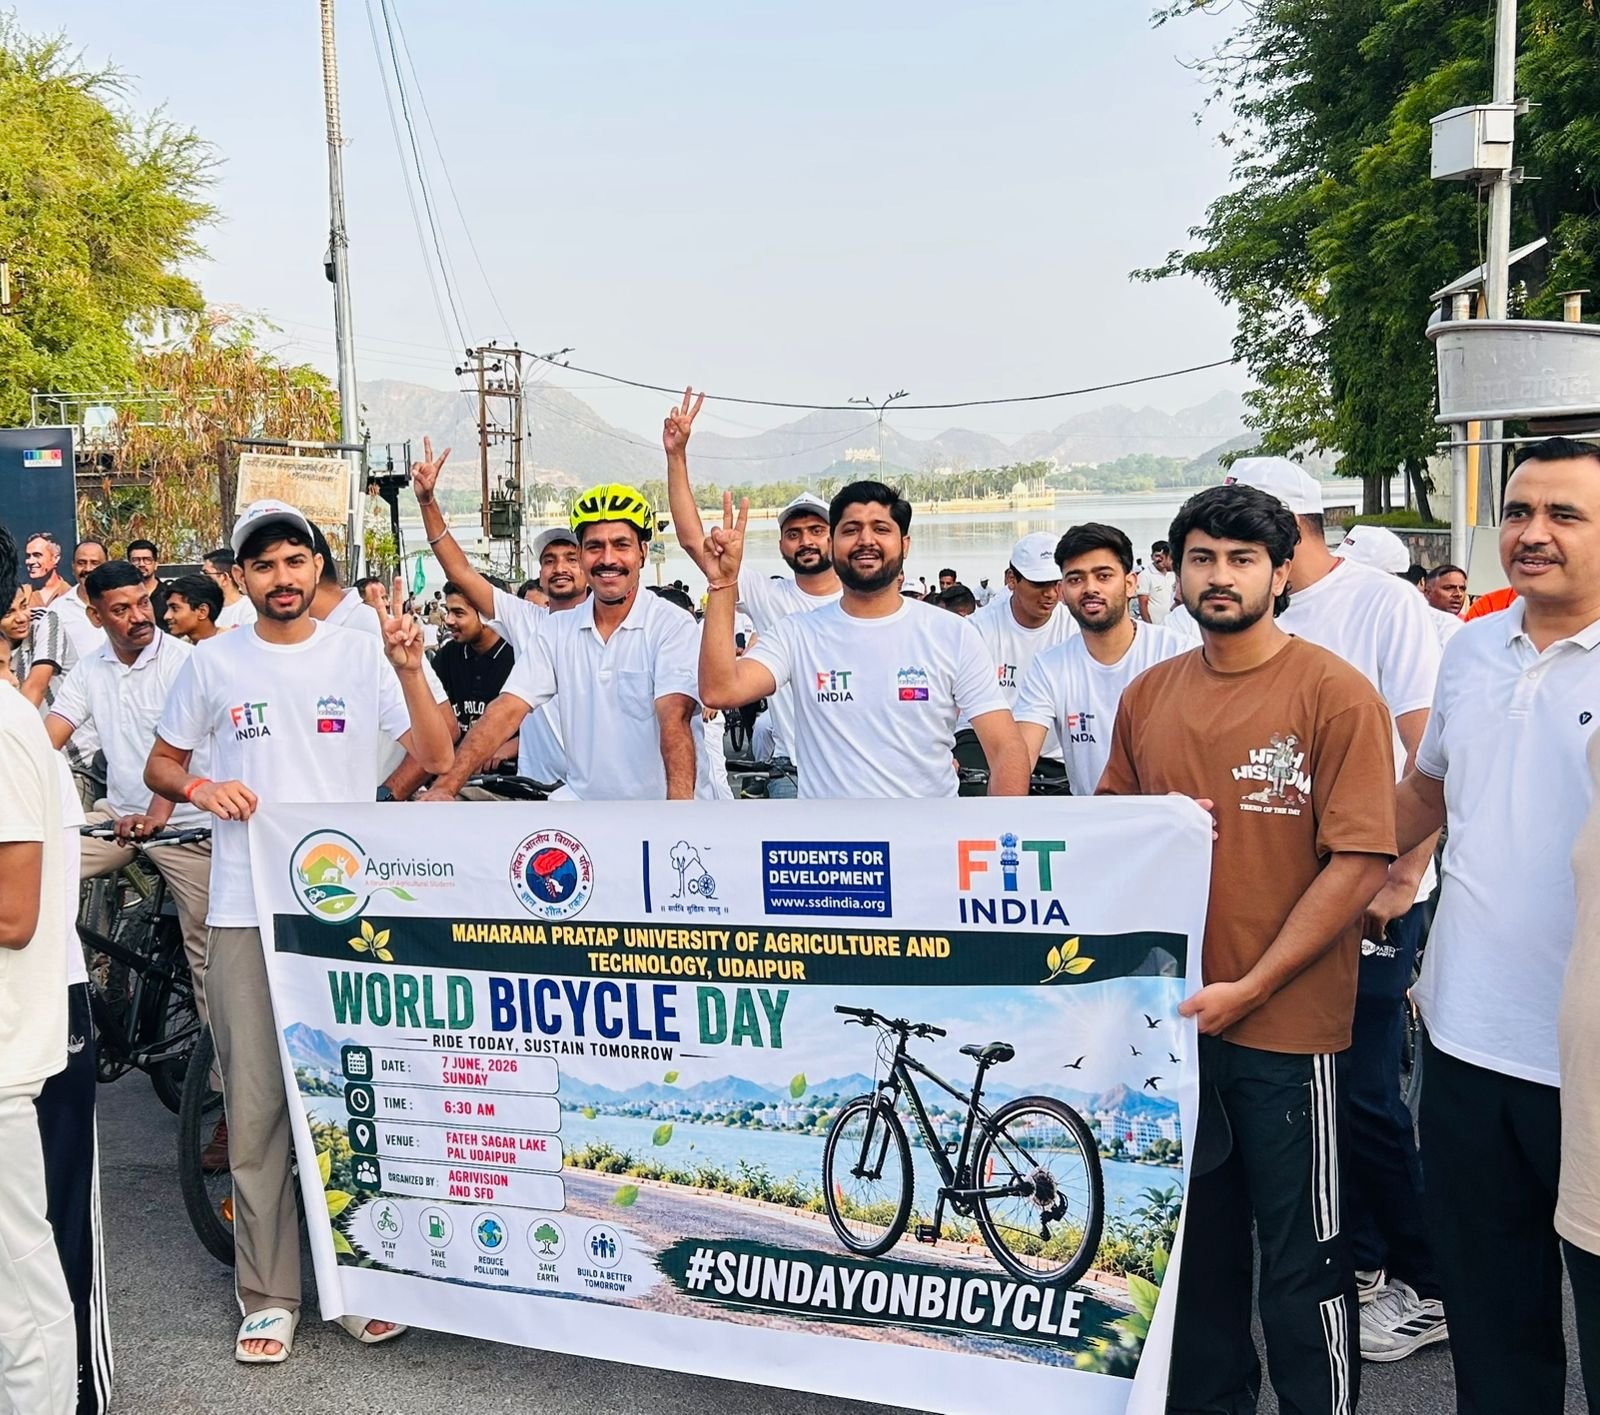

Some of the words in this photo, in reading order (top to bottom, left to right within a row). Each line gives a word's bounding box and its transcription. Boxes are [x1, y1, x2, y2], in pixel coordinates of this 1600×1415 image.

[817, 691, 854, 703] INDIA
[464, 700, 486, 715] POLO
[235, 725, 271, 741] INDIA
[769, 850, 849, 865] STUDENTS
[853, 851, 885, 866] FOR
[365, 857, 455, 881] Agrivision
[769, 870, 885, 886] DEVELOPMENT
[771, 896, 886, 912] www.ssdindia.org
[959, 898, 1071, 926] INDIA
[452, 924, 547, 945] MAHARANA
[551, 926, 619, 947] PRATAP
[622, 928, 730, 951] UNIVERSITY
[735, 931, 759, 953] OF
[763, 933, 902, 957] AGRICULTURE
[906, 937, 952, 959] AND
[587, 952, 712, 980] TECHNOLOGY,
[717, 957, 807, 981] UDAIPUR
[327, 970, 475, 1031] WORLD
[488, 976, 681, 1043] BICYCLE
[696, 985, 791, 1050] DAY
[432, 1034, 463, 1049] RIDE
[470, 1036, 519, 1053] TODAY,
[524, 1038, 585, 1057] SUSTAIN
[590, 1042, 674, 1061] TOMORROW
[442, 1056, 449, 1069] 7
[452, 1058, 484, 1073] JUNE,
[488, 1059, 518, 1073] 2026
[442, 1072, 489, 1087] SUNDAY
[444, 1100, 472, 1115] 6:30
[477, 1103, 496, 1117] AM
[446, 1131, 478, 1147] FATEH
[481, 1135, 516, 1150] SAGAR
[519, 1139, 547, 1153] LAKE
[447, 1146, 467, 1160] PAL
[470, 1148, 517, 1165] UDAIPUR
[388, 1171, 424, 1185] ORGANIZED
[448, 1169, 509, 1187] AGRIVISION
[449, 1184, 471, 1198] AND
[474, 1186, 494, 1200] SFD
[381, 1241, 396, 1251] STAY
[430, 1249, 446, 1259] SAVE
[384, 1250, 394, 1260] FIT
[478, 1256, 504, 1267] REDUCE
[431, 1259, 447, 1269] FUEL
[474, 1266, 510, 1278] POLLUTION
[538, 1263, 557, 1274] SAVE
[537, 1272, 559, 1284] EARTH
[577, 1268, 599, 1280] BUILD
[600, 1271, 605, 1281] A
[606, 1272, 633, 1284] BETTER
[584, 1279, 626, 1293] TOMORROW
[685, 1246, 1085, 1339] #SUNDAYONBICYCLE
